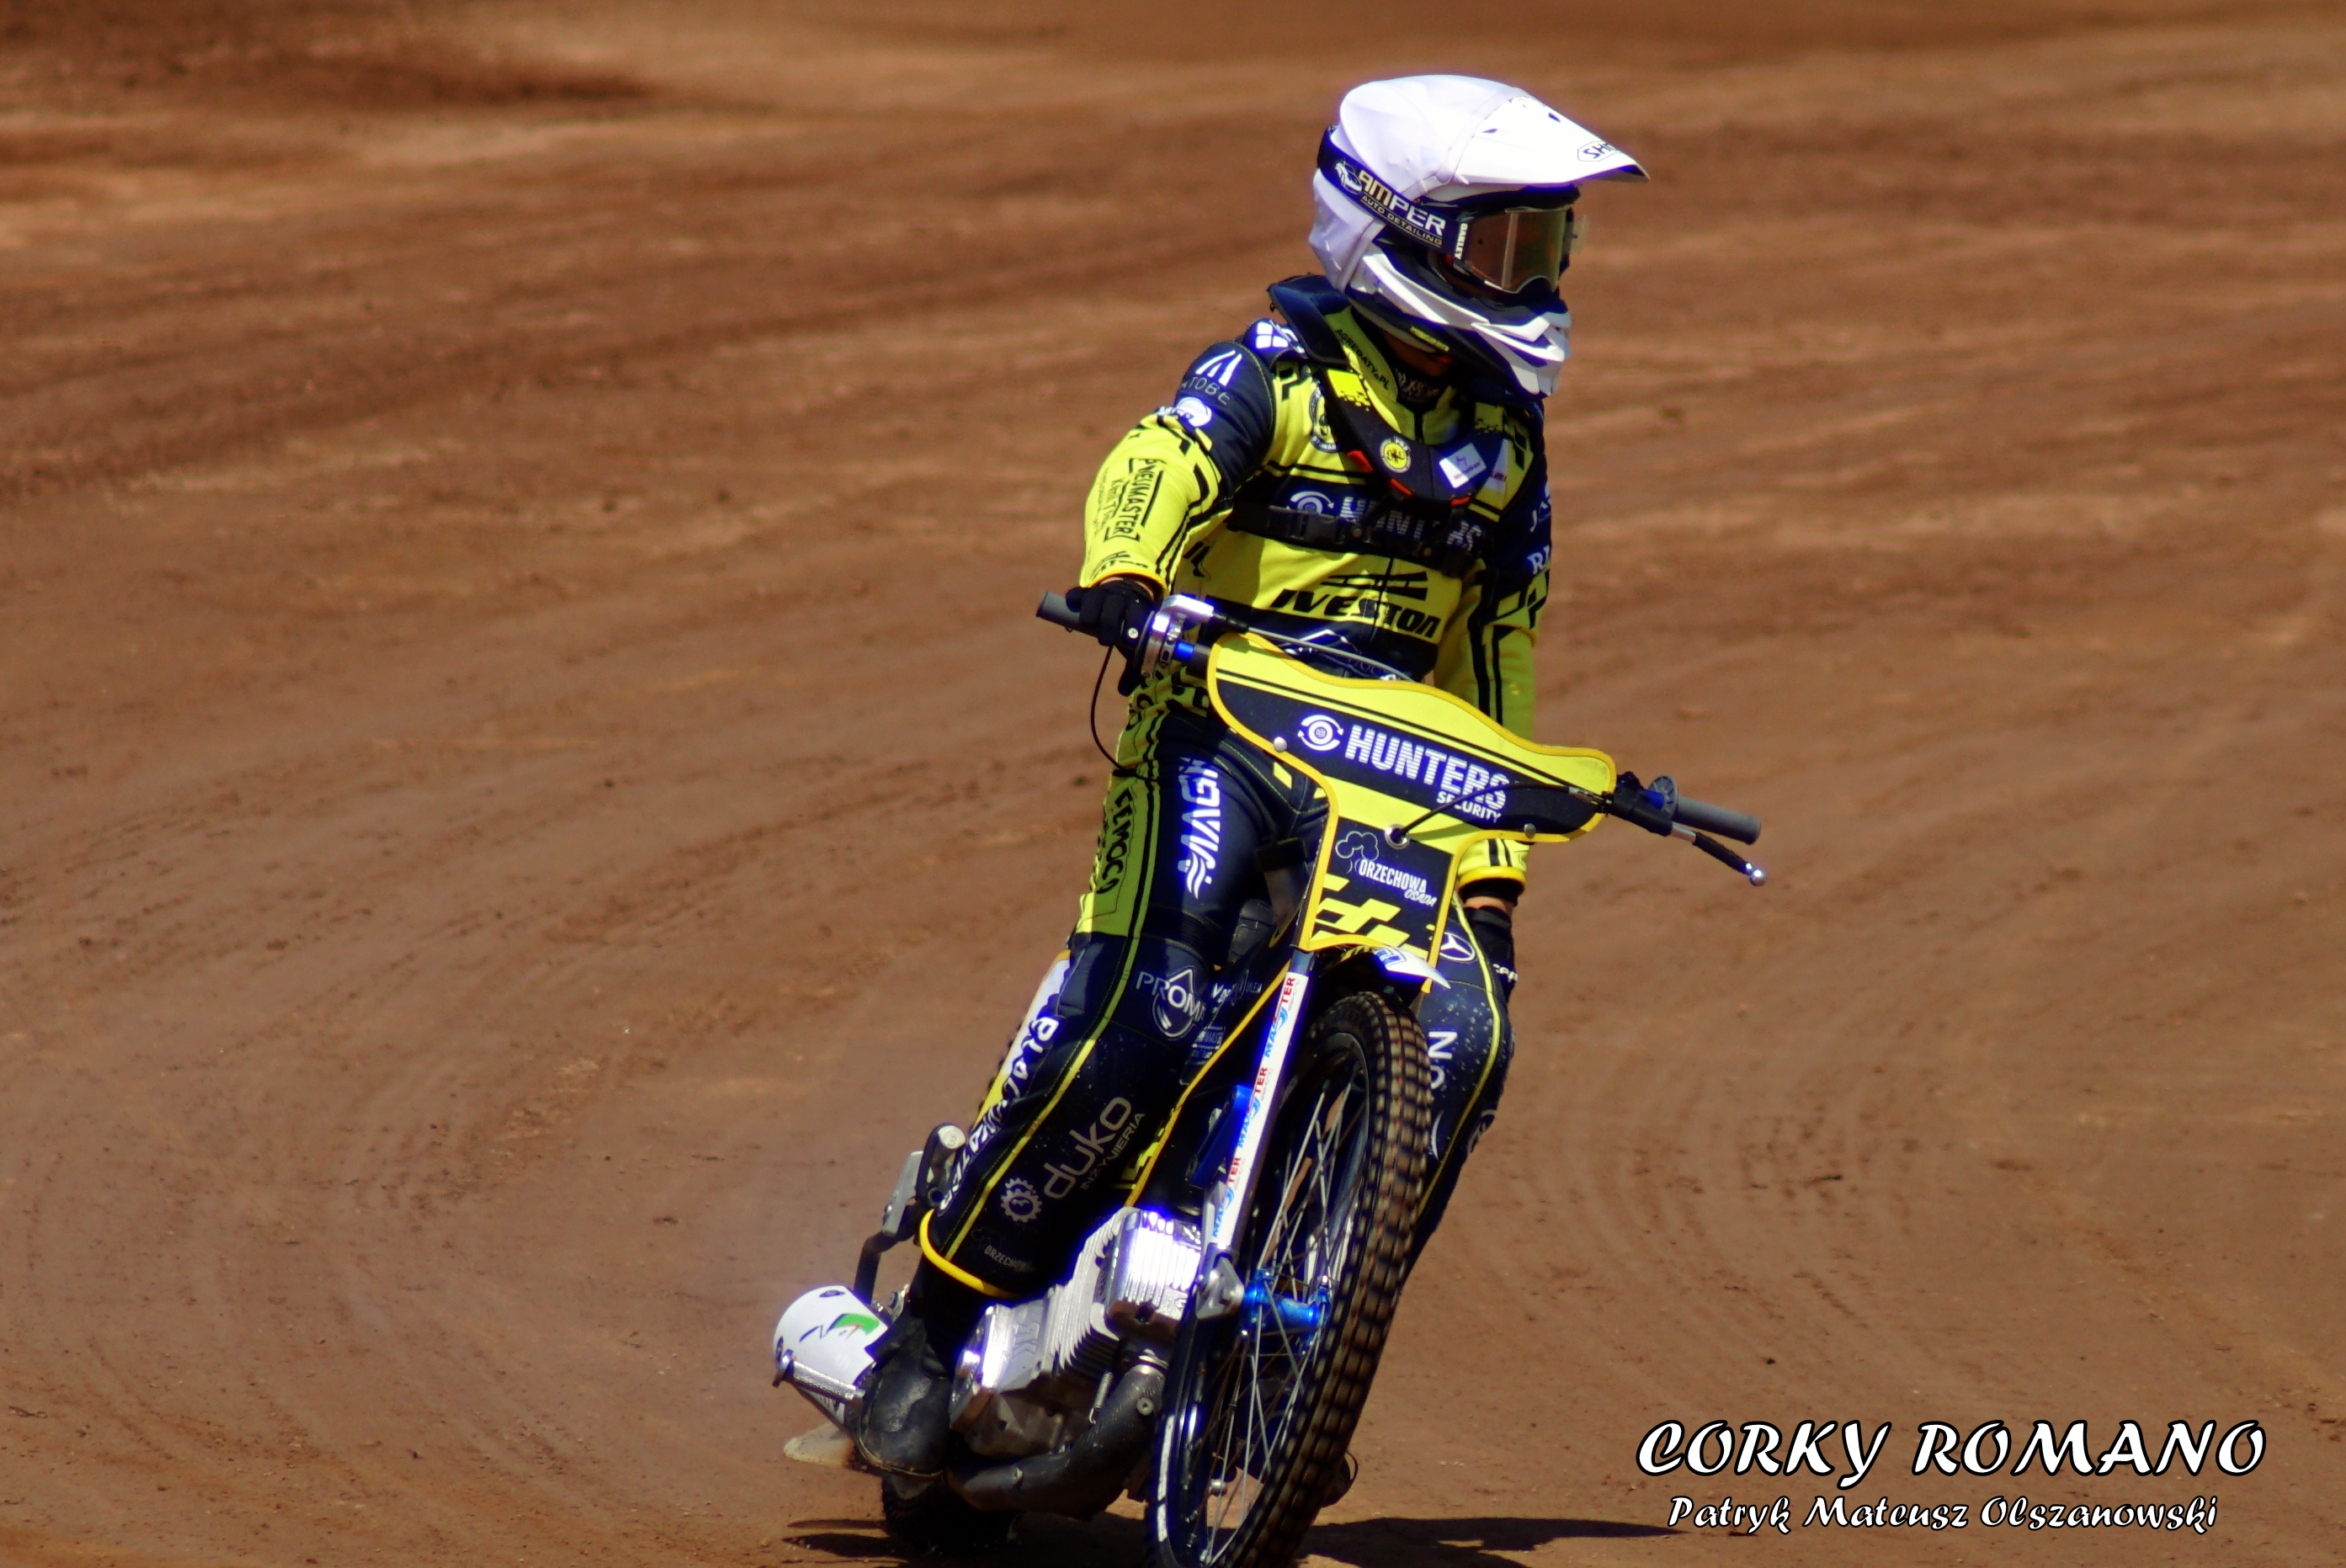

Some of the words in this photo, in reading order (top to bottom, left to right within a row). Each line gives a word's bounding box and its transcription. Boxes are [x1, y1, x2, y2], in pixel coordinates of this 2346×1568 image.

[1358, 169, 1446, 237] AMPER
[1361, 194, 1386, 214] AUTO
[1388, 213, 1443, 246] DETAILING
[1455, 223, 1468, 260] OAKLEY
[1114, 459, 1157, 536] PNEUMASTER
[1345, 724, 1509, 810] HUNTERS
[1436, 790, 1502, 823] SEURITY
[1359, 858, 1427, 893] ORZECHOWA
[1404, 888, 1437, 907] OSADA
[1044, 1097, 1131, 1199] duko
